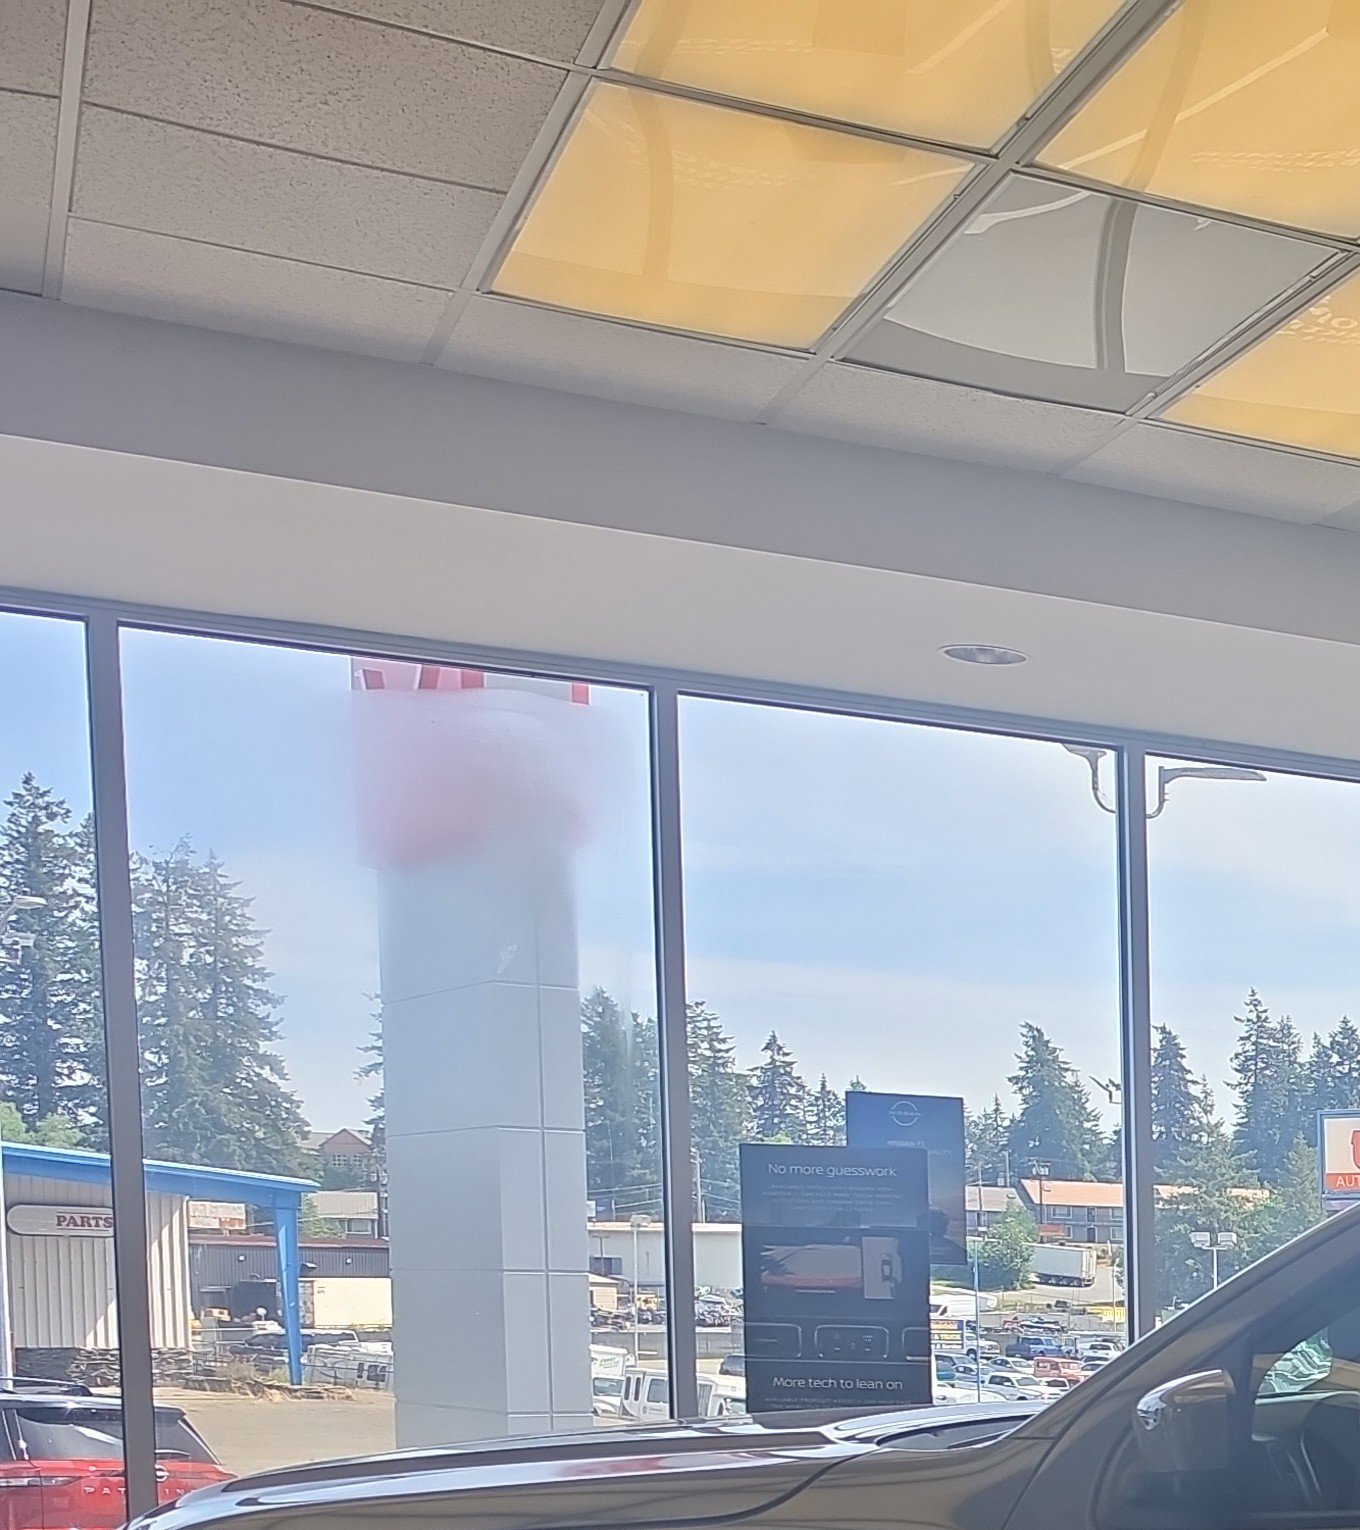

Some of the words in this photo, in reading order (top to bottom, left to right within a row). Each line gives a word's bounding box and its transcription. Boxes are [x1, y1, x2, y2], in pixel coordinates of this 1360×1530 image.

[768, 1163, 786, 1175] No
[789, 1166, 824, 1175] more
[826, 1165, 898, 1178] guesswork
[56, 1214, 113, 1229] PARTS
[773, 1377, 806, 1388] More
[808, 1378, 837, 1389] tech
[840, 1379, 854, 1389] to
[856, 1378, 884, 1390] lean
[886, 1381, 903, 1390] on
